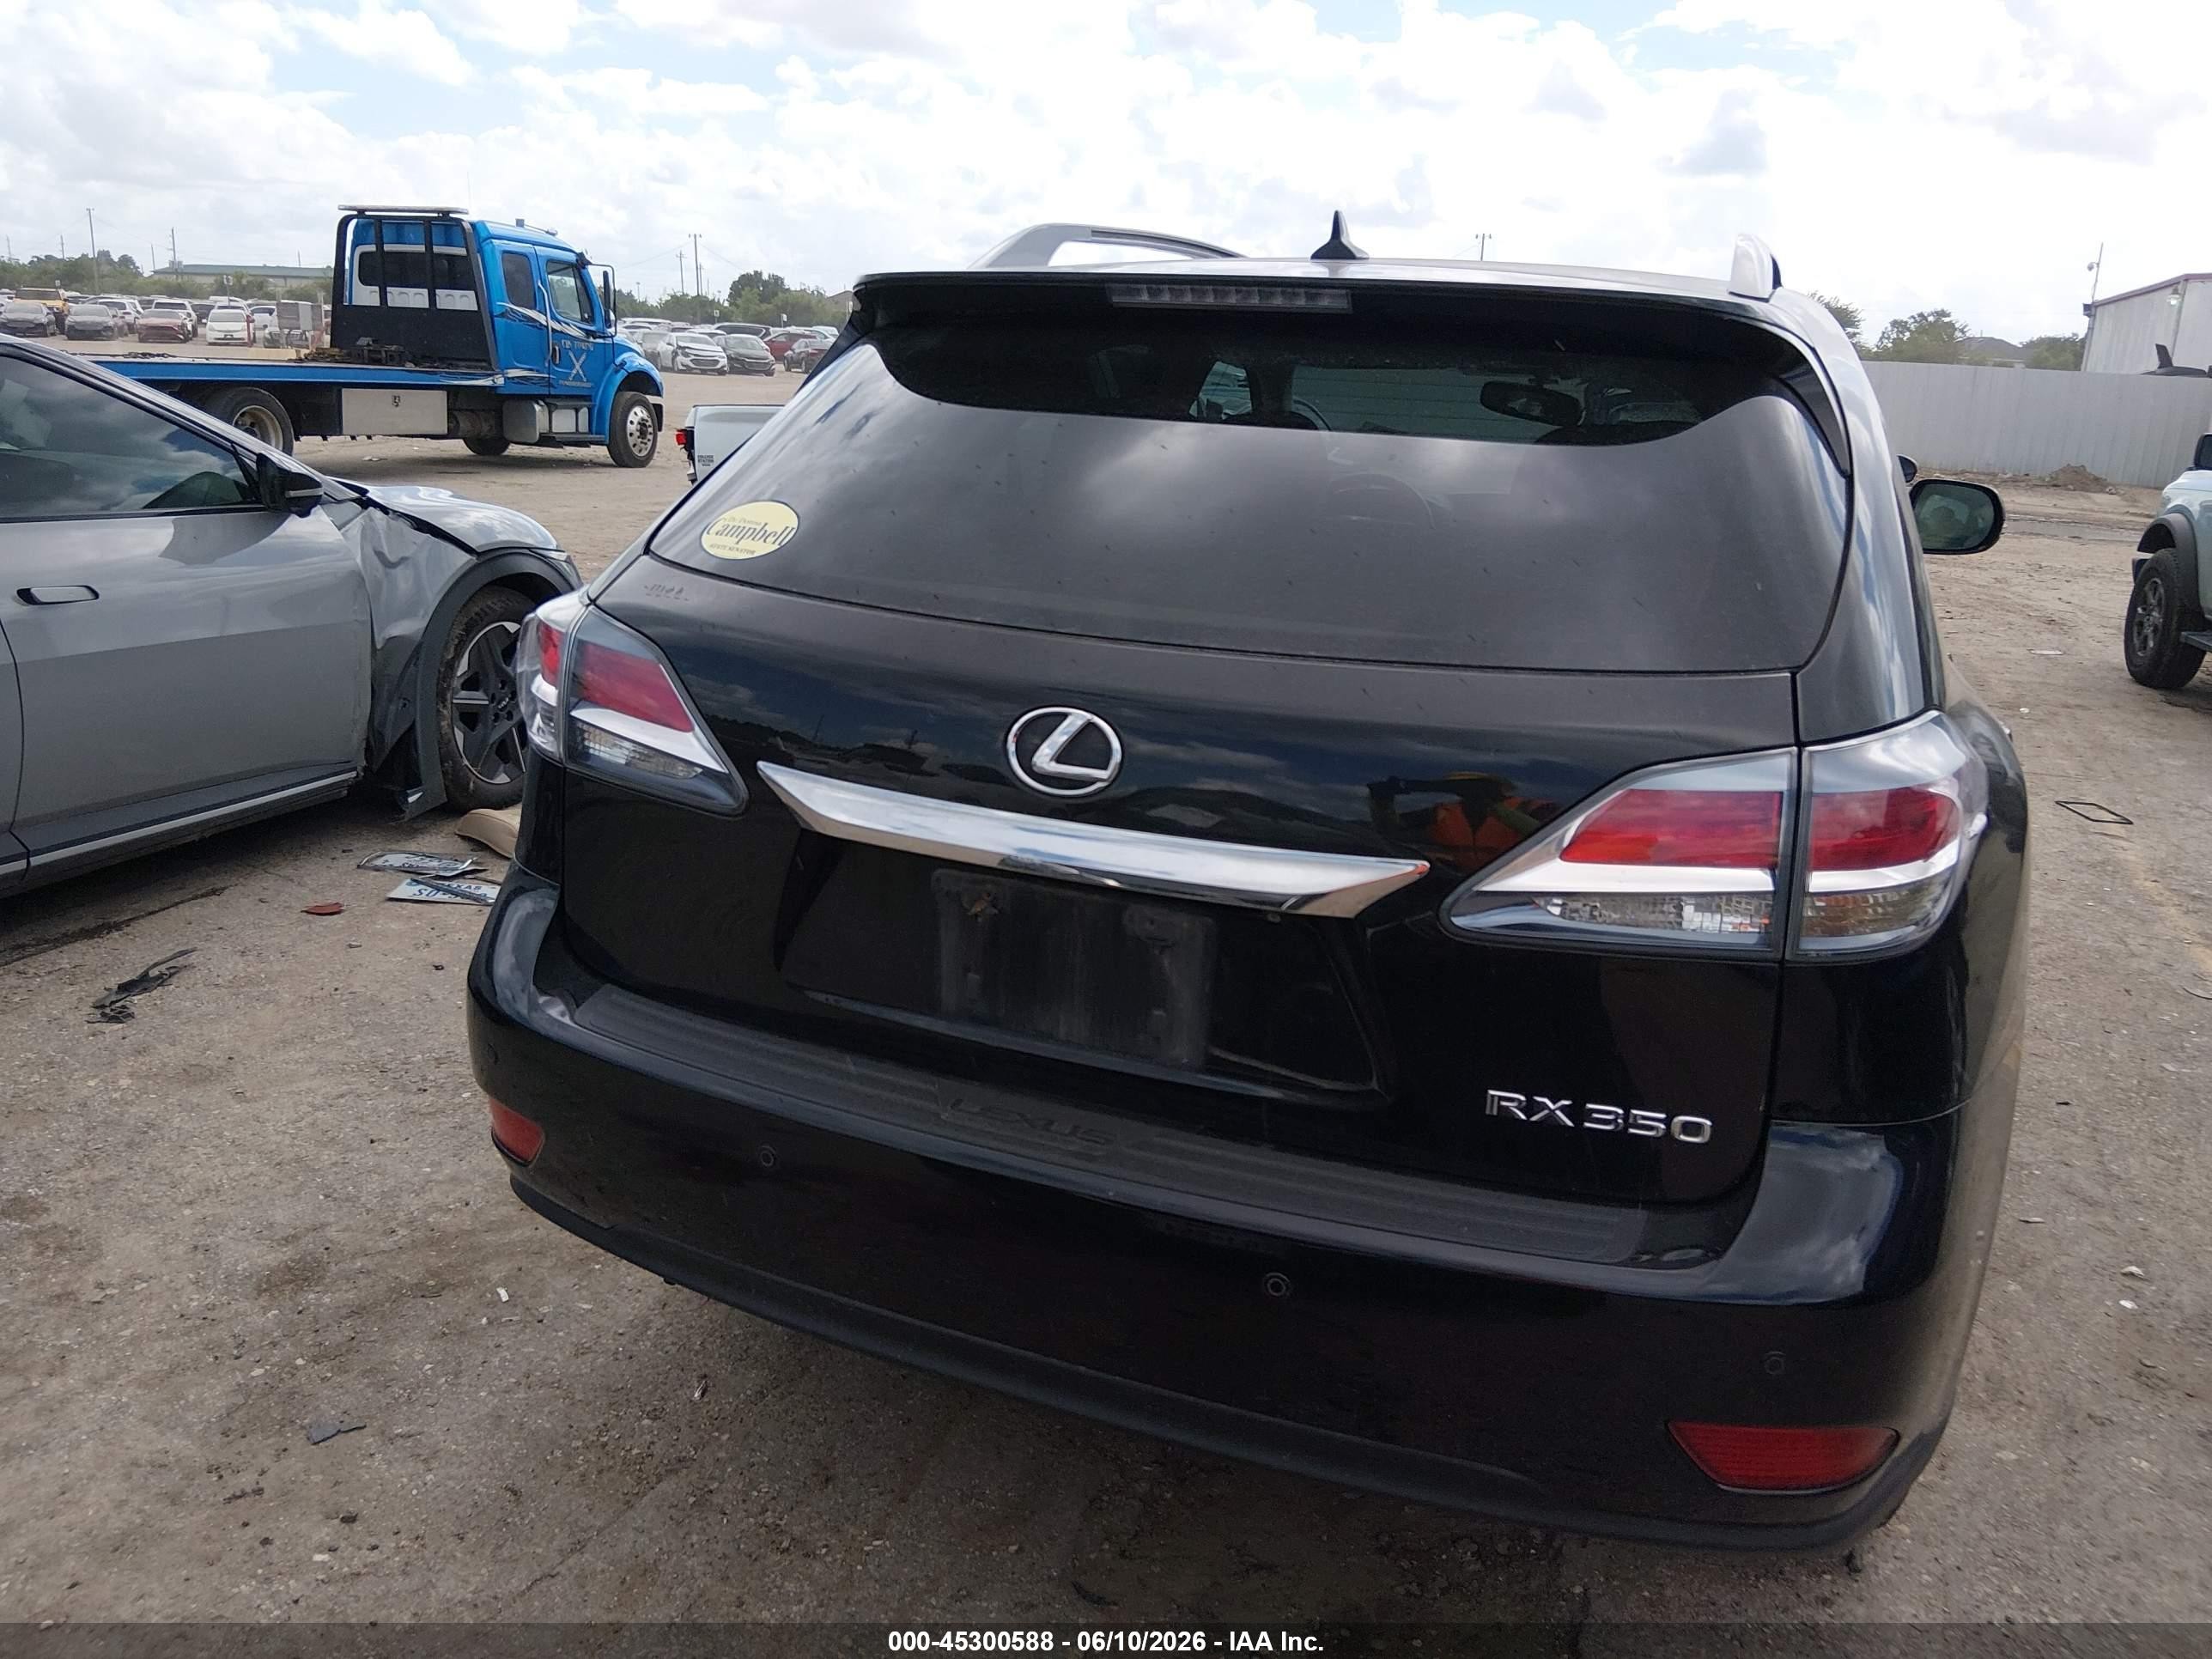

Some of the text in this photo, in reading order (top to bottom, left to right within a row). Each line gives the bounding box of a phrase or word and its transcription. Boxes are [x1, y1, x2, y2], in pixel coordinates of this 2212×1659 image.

[706, 519, 795, 546] Campbell
[1486, 1089, 1712, 1144] RX 350
